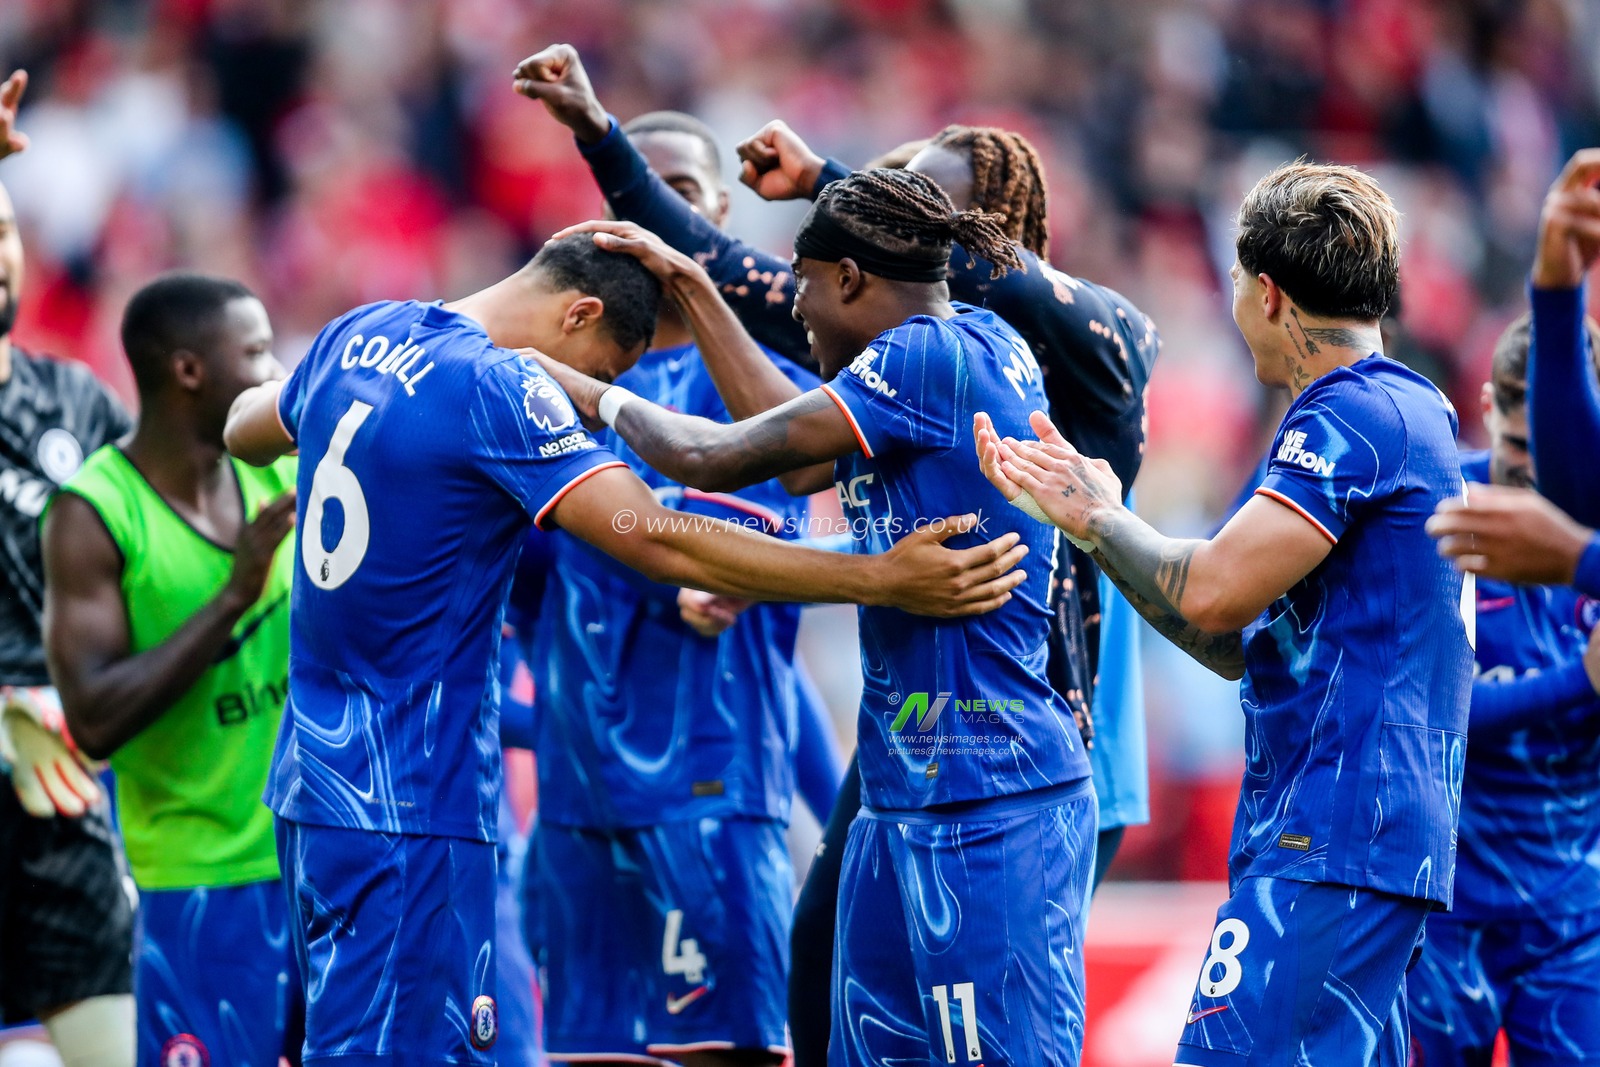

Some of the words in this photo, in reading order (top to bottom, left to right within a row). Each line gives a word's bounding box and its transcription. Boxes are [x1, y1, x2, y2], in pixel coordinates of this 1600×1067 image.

[539, 442, 560, 458] No
[302, 399, 374, 591] 6
[661, 908, 707, 984] 4
[1199, 917, 1250, 998] 8
[932, 982, 982, 1064] 11
